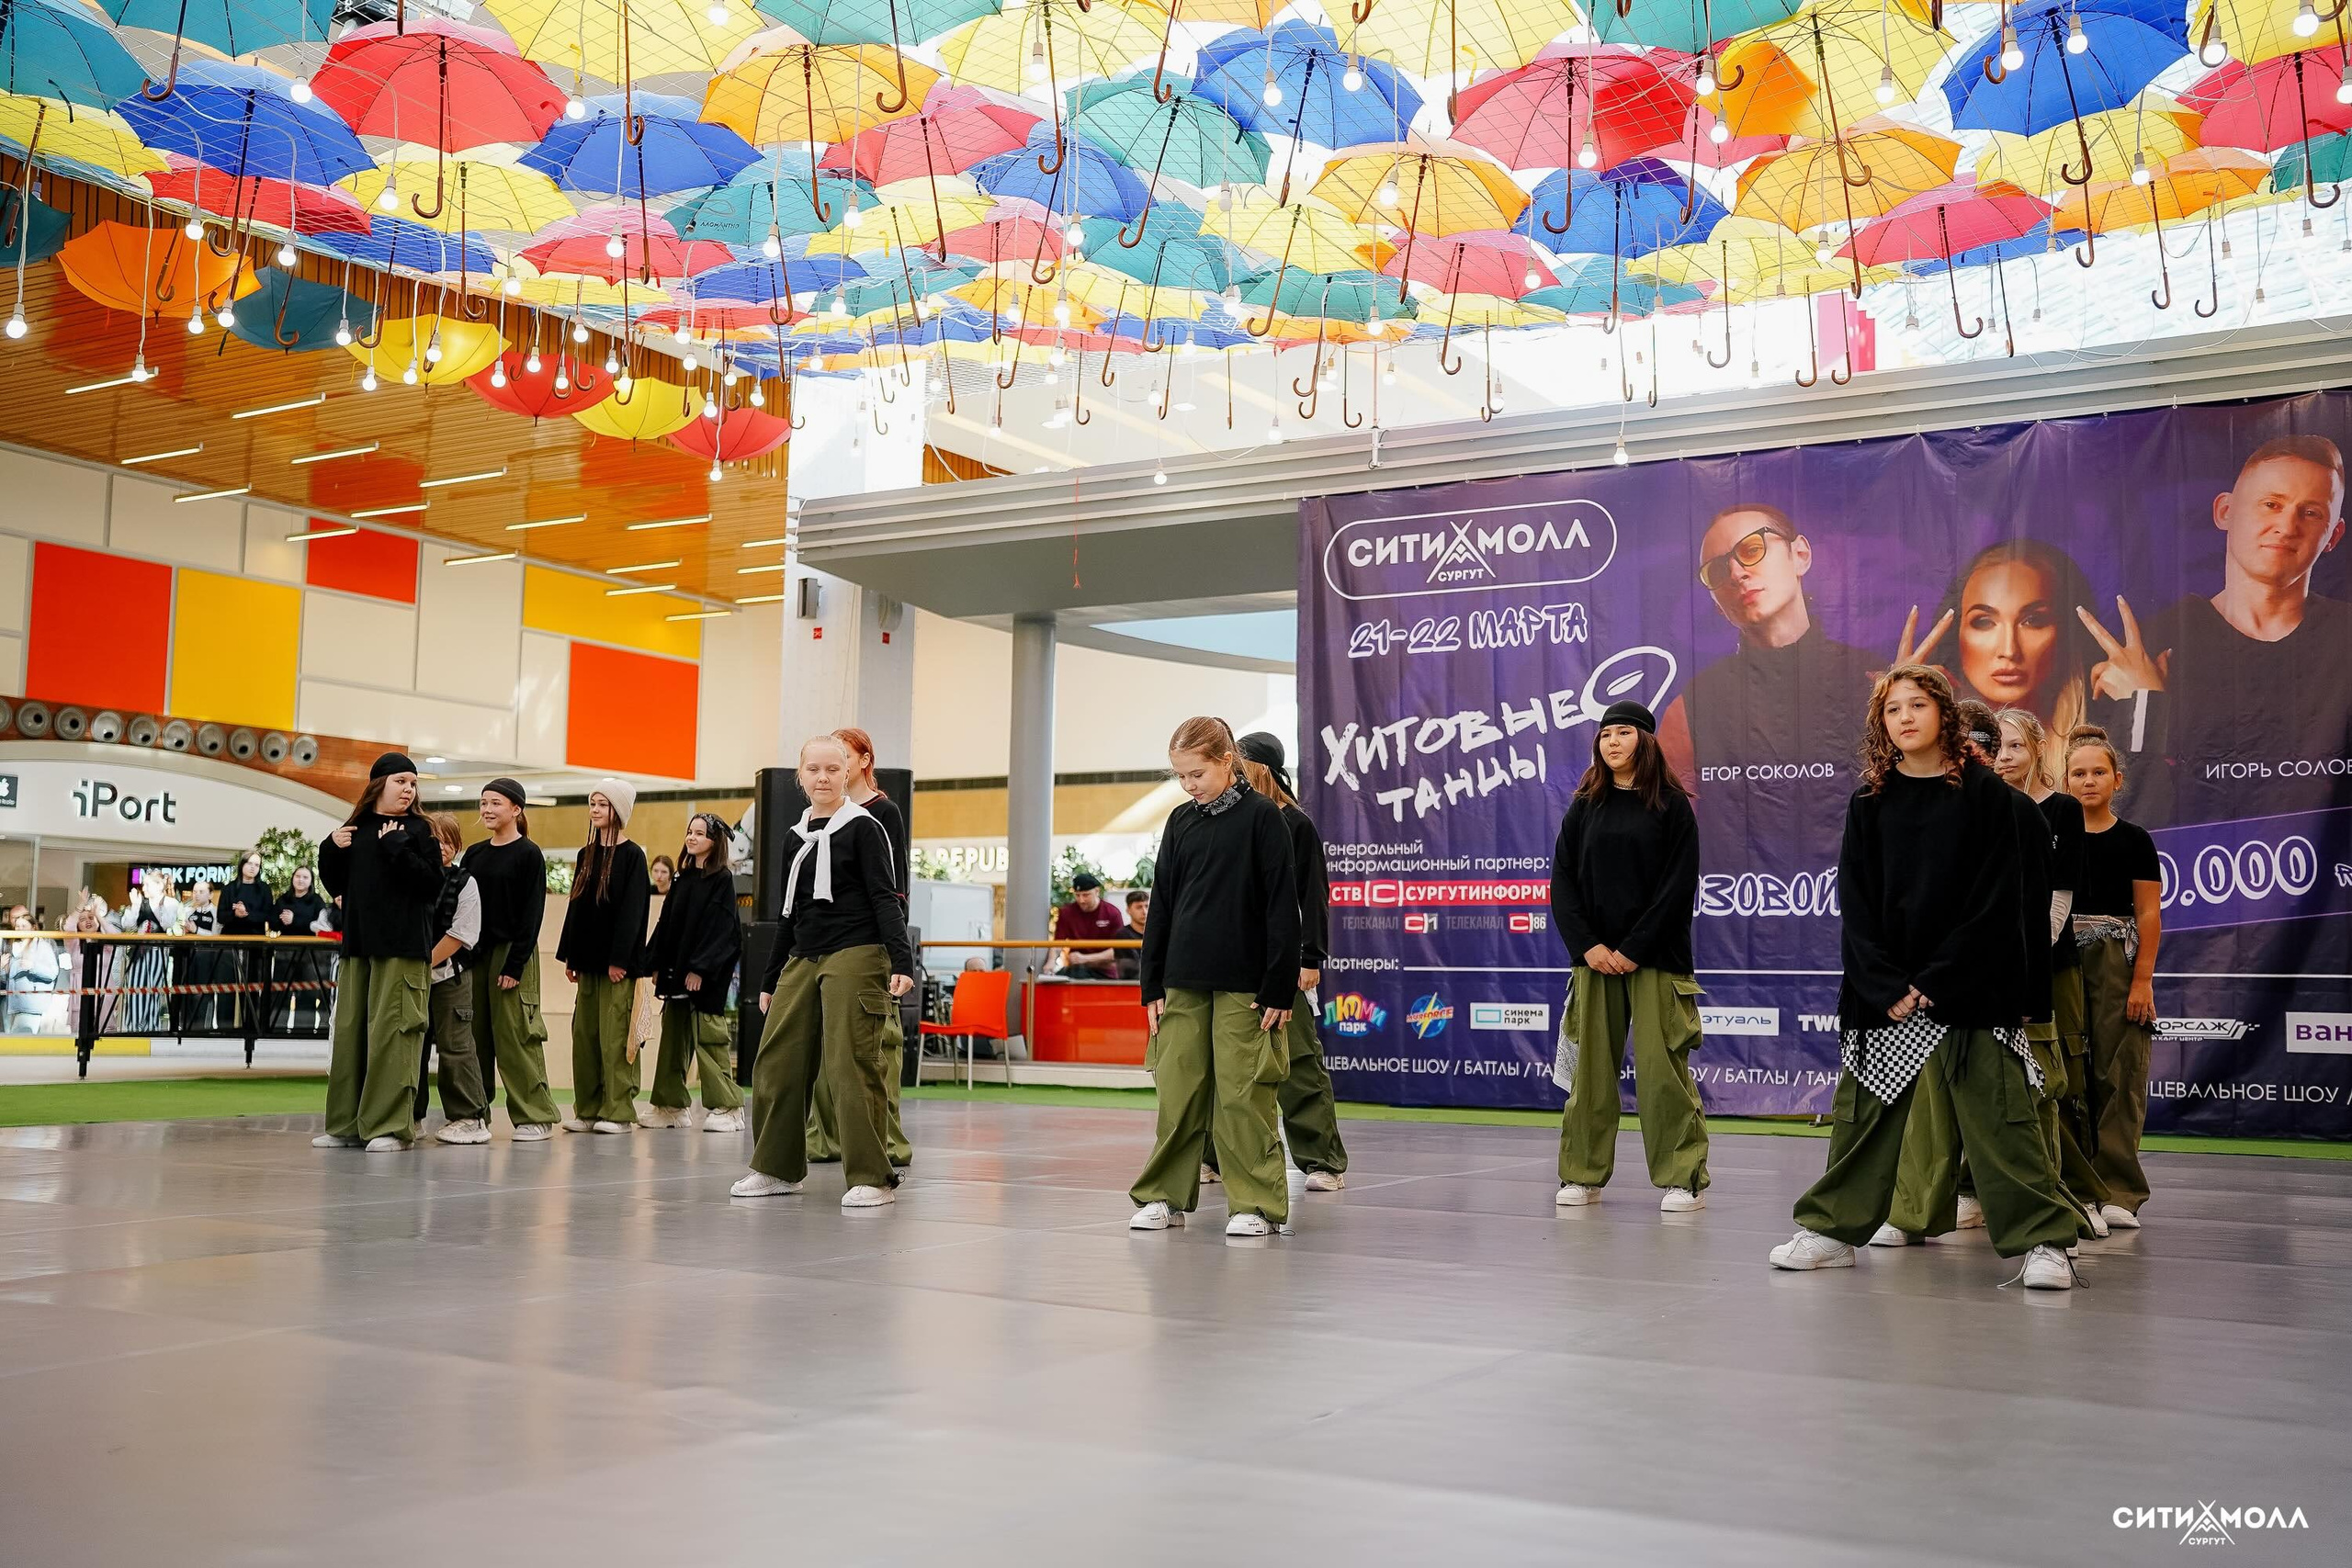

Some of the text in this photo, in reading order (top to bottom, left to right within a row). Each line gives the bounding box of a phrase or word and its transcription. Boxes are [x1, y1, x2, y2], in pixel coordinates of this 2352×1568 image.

[1438, 568, 1484, 581] СУРГУТ
[1348, 603, 1588, 659] 21-22 МАРТА
[1320, 689, 1589, 791] ХИТОВЫЕ
[1702, 763, 1834, 781] ЕГОР СОКОЛОВ
[2206, 762, 2272, 779] ИГОРЬ
[1377, 744, 1546, 822] ТАНЦЫ
[73, 780, 176, 823] iPort
[1323, 840, 1423, 858] Генеральный
[1475, 856, 1549, 873] партнер:
[140, 866, 233, 884] MRK FORM
[1693, 866, 1841, 917] ЗОВОЙ
[1342, 916, 1398, 930] ТЕЛЕКАНАЛ
[1446, 916, 1504, 930] ТЕЛЕКАНАЛ
[1323, 955, 1399, 973] Партнеры:
[1324, 995, 1386, 1026] ЛЮМИ
[1504, 1009, 1544, 1017] синема
[1339, 1021, 1367, 1035] парк
[1504, 1017, 1531, 1026] парк
[1323, 1056, 1408, 1073] ЦЕВАЛЬНОЕ
[1412, 1058, 1449, 1075] ШОУ
[1464, 1059, 1520, 1077] БАТТЛЫ
[1536, 1062, 1555, 1077] ТА
[1724, 1068, 1789, 1085] БАТТЛЫ
[1805, 1070, 1842, 1086] ТАН
[2146, 1080, 2277, 1100] ЦЕВАЛЬНОЕ
[2284, 1085, 2338, 1103] ШОУ
